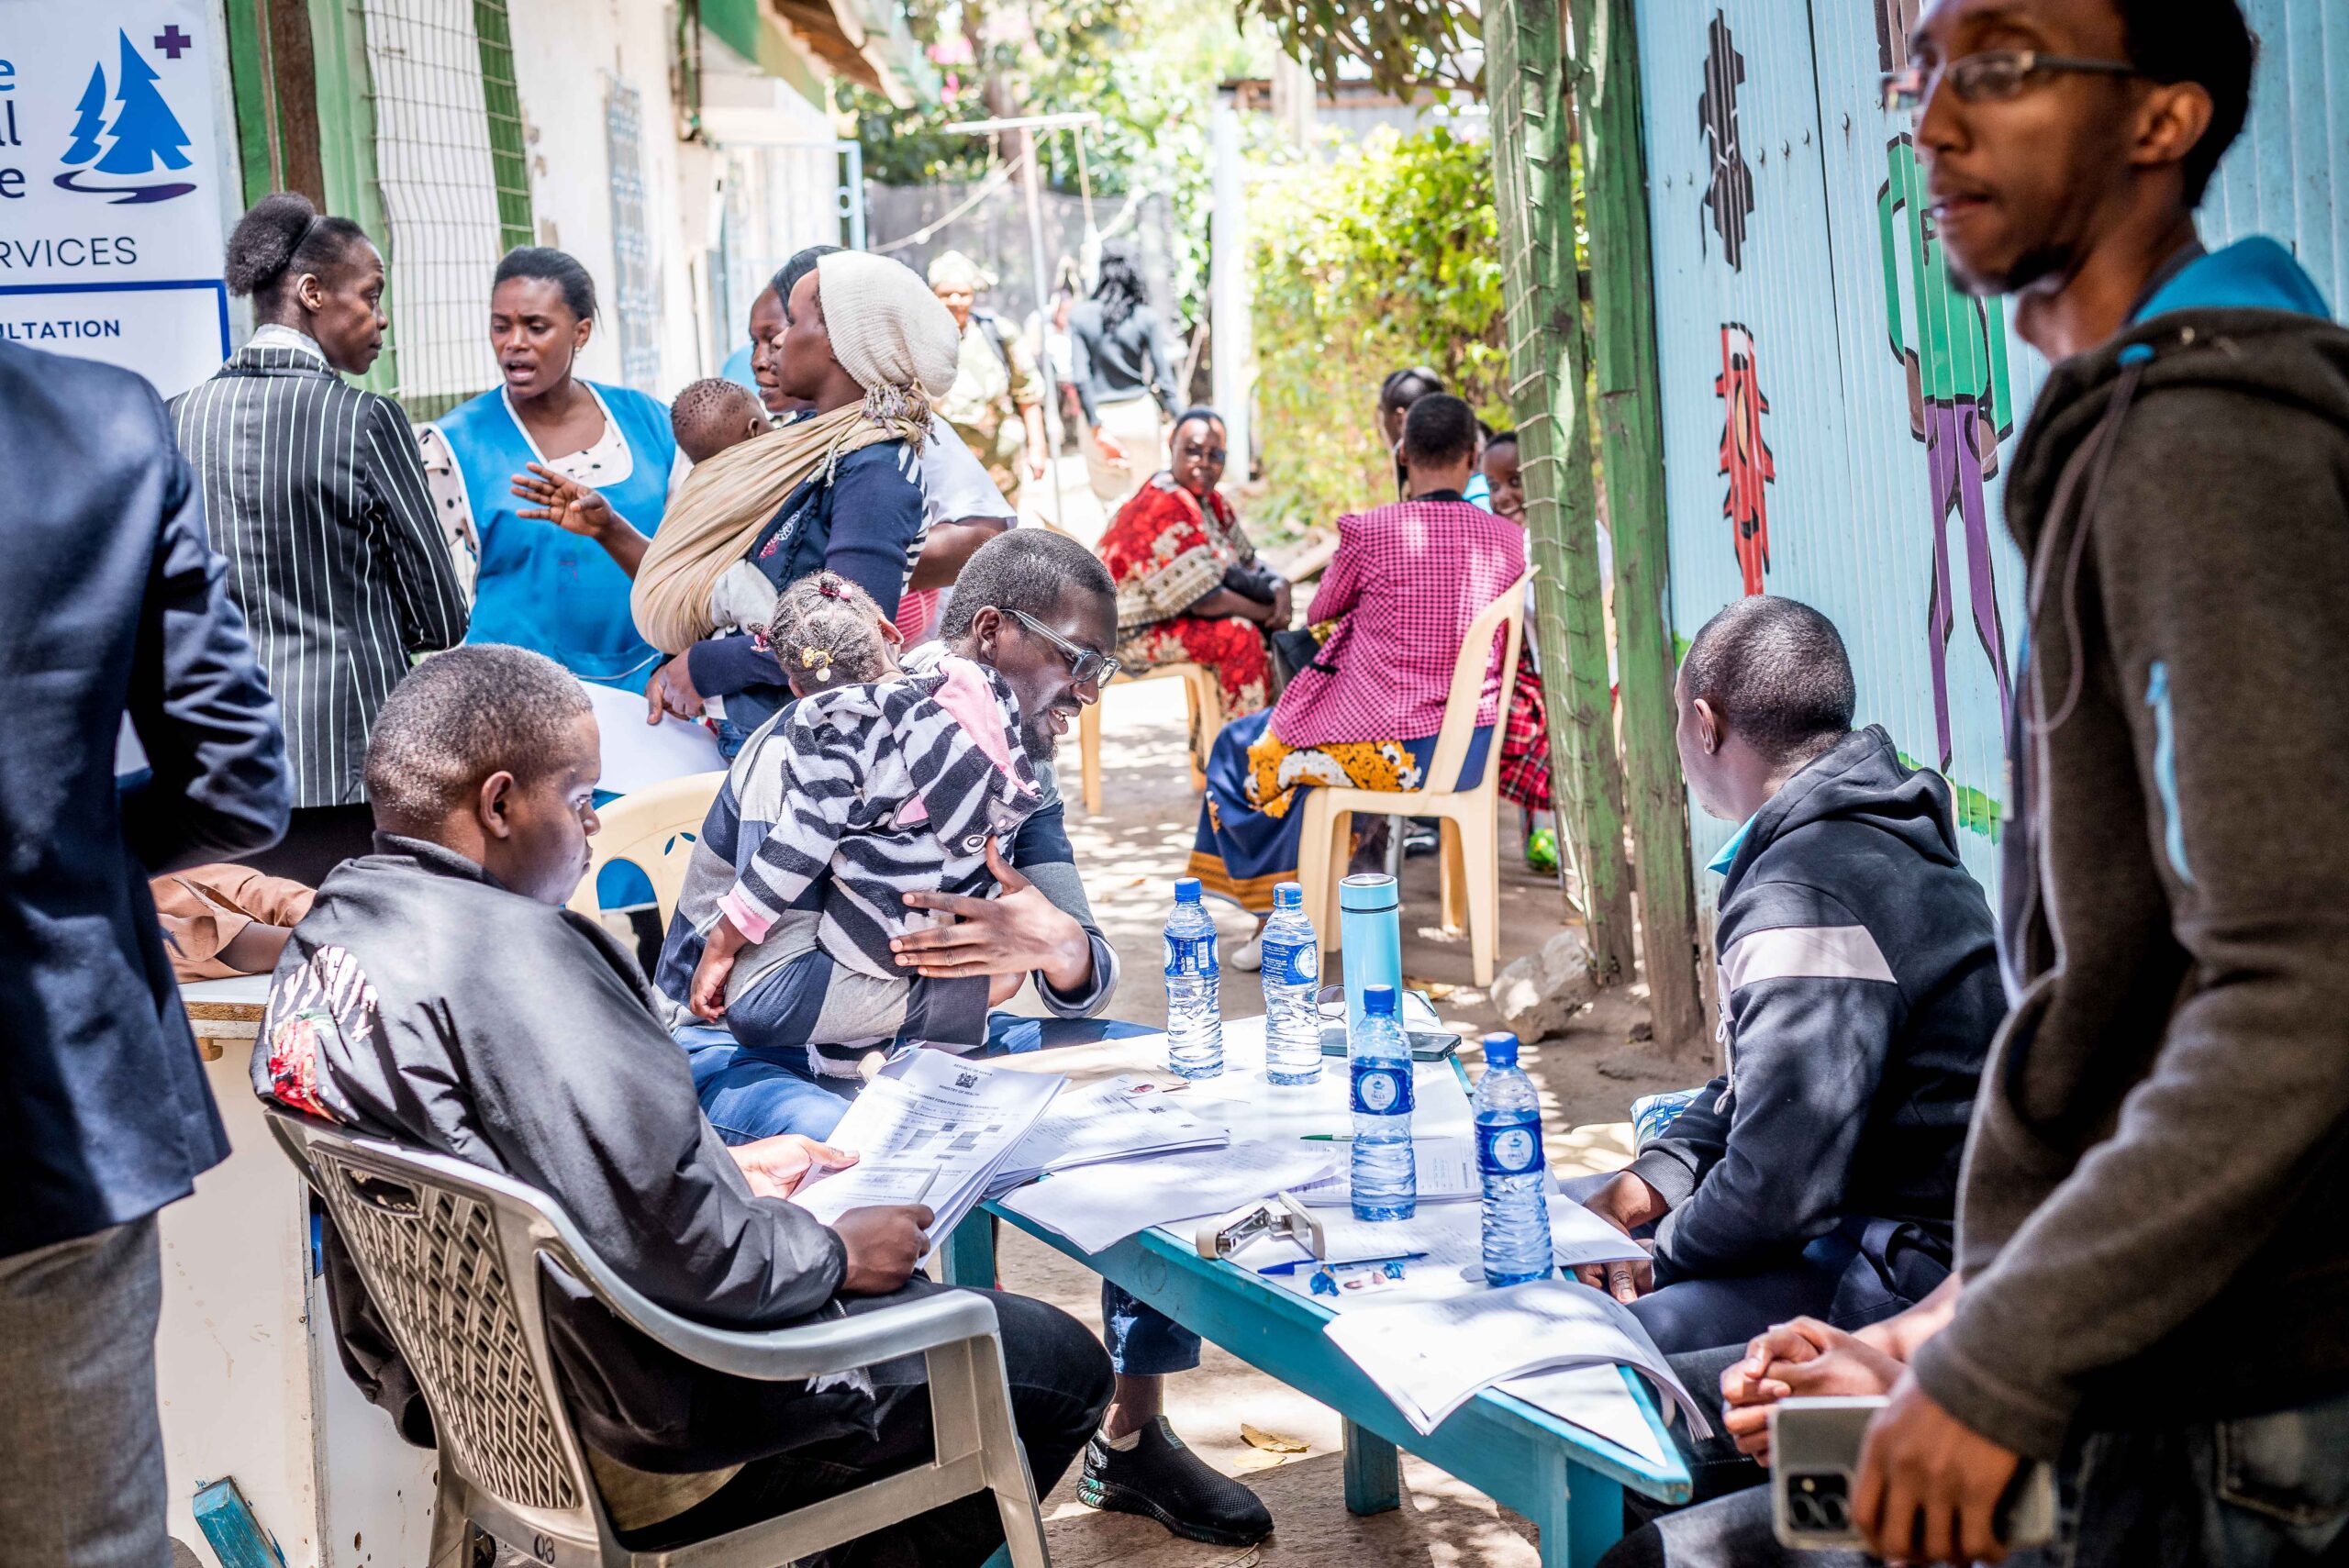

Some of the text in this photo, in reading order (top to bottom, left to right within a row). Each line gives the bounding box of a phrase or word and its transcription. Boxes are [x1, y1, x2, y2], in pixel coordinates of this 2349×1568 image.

[0, 99, 22, 147] l
[0, 237, 138, 269] RVICES
[0, 319, 120, 339] LTATION
[939, 1084, 958, 1094] MINISTRY
